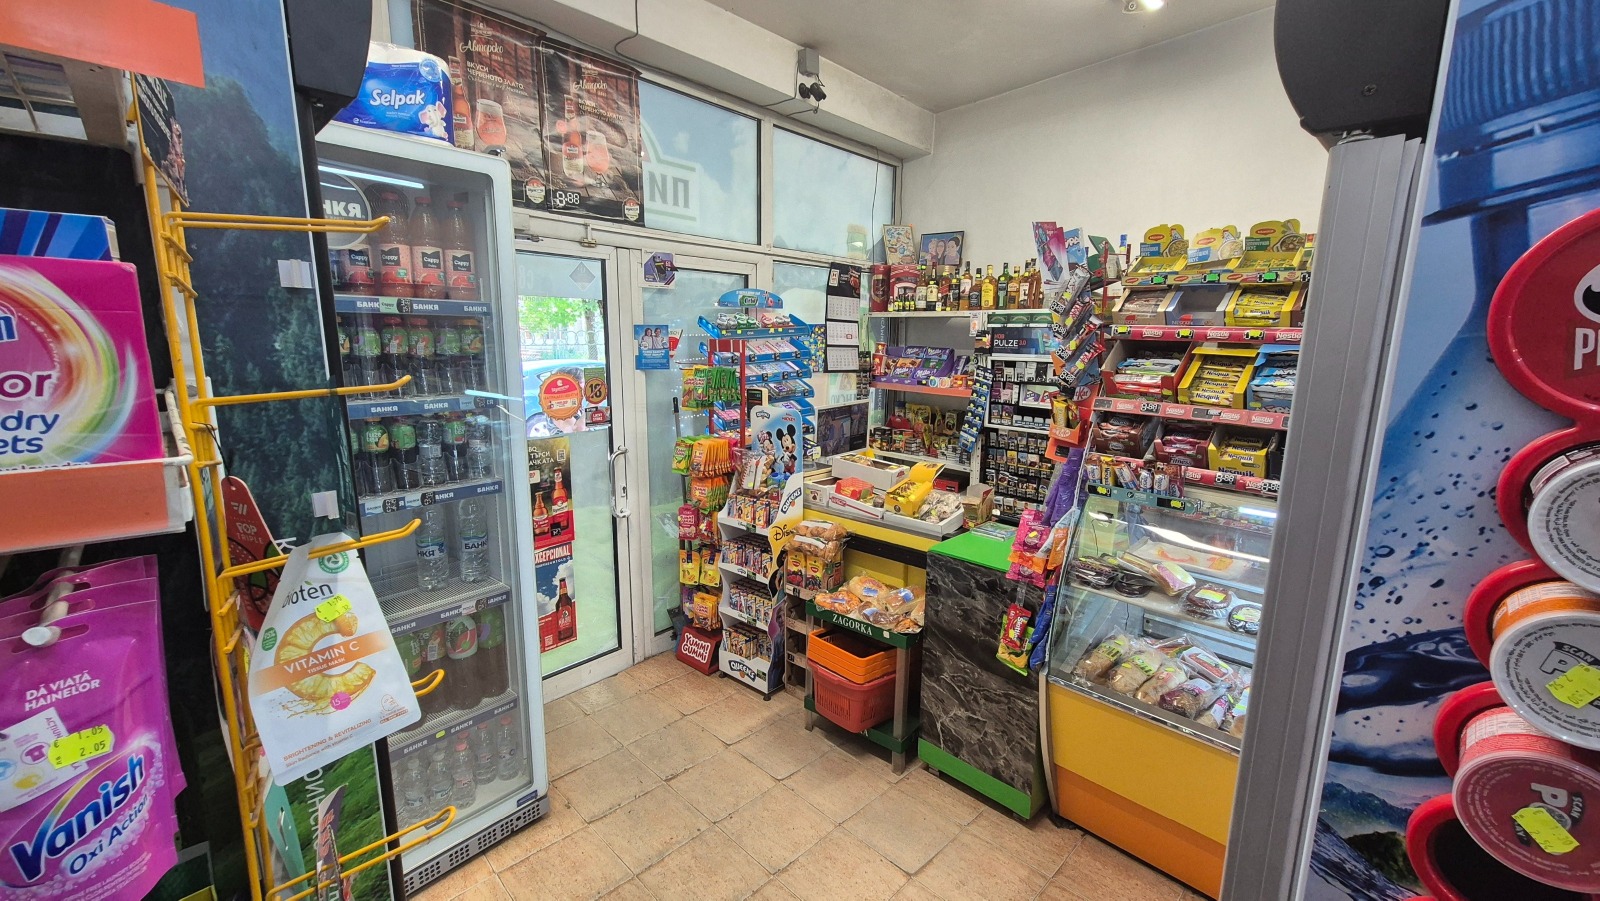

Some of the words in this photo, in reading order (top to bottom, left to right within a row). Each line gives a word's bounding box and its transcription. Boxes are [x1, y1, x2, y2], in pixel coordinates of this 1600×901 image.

[466, 61, 489, 72] ВКУСИ
[370, 89, 425, 110] Selpak
[323, 200, 363, 219] НКЯ
[423, 256, 440, 264] Cappy
[413, 303, 439, 311] БАНКЯ
[994, 339, 1018, 347] PULZE
[589, 383, 603, 399] 18
[1195, 393, 1220, 401] Nesquik
[371, 405, 399, 413] БАНКЯ
[424, 402, 449, 410] БАНКЯ
[530, 451, 551, 459] ТЪРСИ
[1228, 453, 1253, 462] Nesquik
[528, 458, 555, 466] АЧКАТА
[1218, 467, 1255, 478] Nesquik
[477, 484, 499, 493] БАНКЯ
[236, 533, 264, 545] TRIPLE
[464, 539, 488, 550] БАНК
[417, 548, 435, 558] НКЯ
[535, 544, 571, 564] XCEPCIONAL
[488, 594, 507, 604] АНКЯ
[391, 622, 417, 634] БАНКЯ
[832, 613, 873, 636] ZAGORKA
[283, 646, 346, 674] VITAMIN
[349, 641, 360, 652] C
[1562, 645, 1595, 663] SCAN
[307, 664, 328, 674] TISSUE
[328, 657, 346, 667] MASK
[24, 678, 101, 712] HAINELOR
[494, 703, 514, 715] БАНКЯ
[450, 719, 473, 734] БАНКЯ
[283, 738, 327, 762] BRIGHTENING
[334, 718, 372, 739] REVITALIZING
[79, 739, 106, 758] 2.05
[403, 740, 428, 754] БАНКЯ
[1571, 795, 1583, 819] SCAN
[11, 753, 145, 883] Vanish
[70, 837, 105, 876] Oxi
[107, 793, 149, 847] Action
